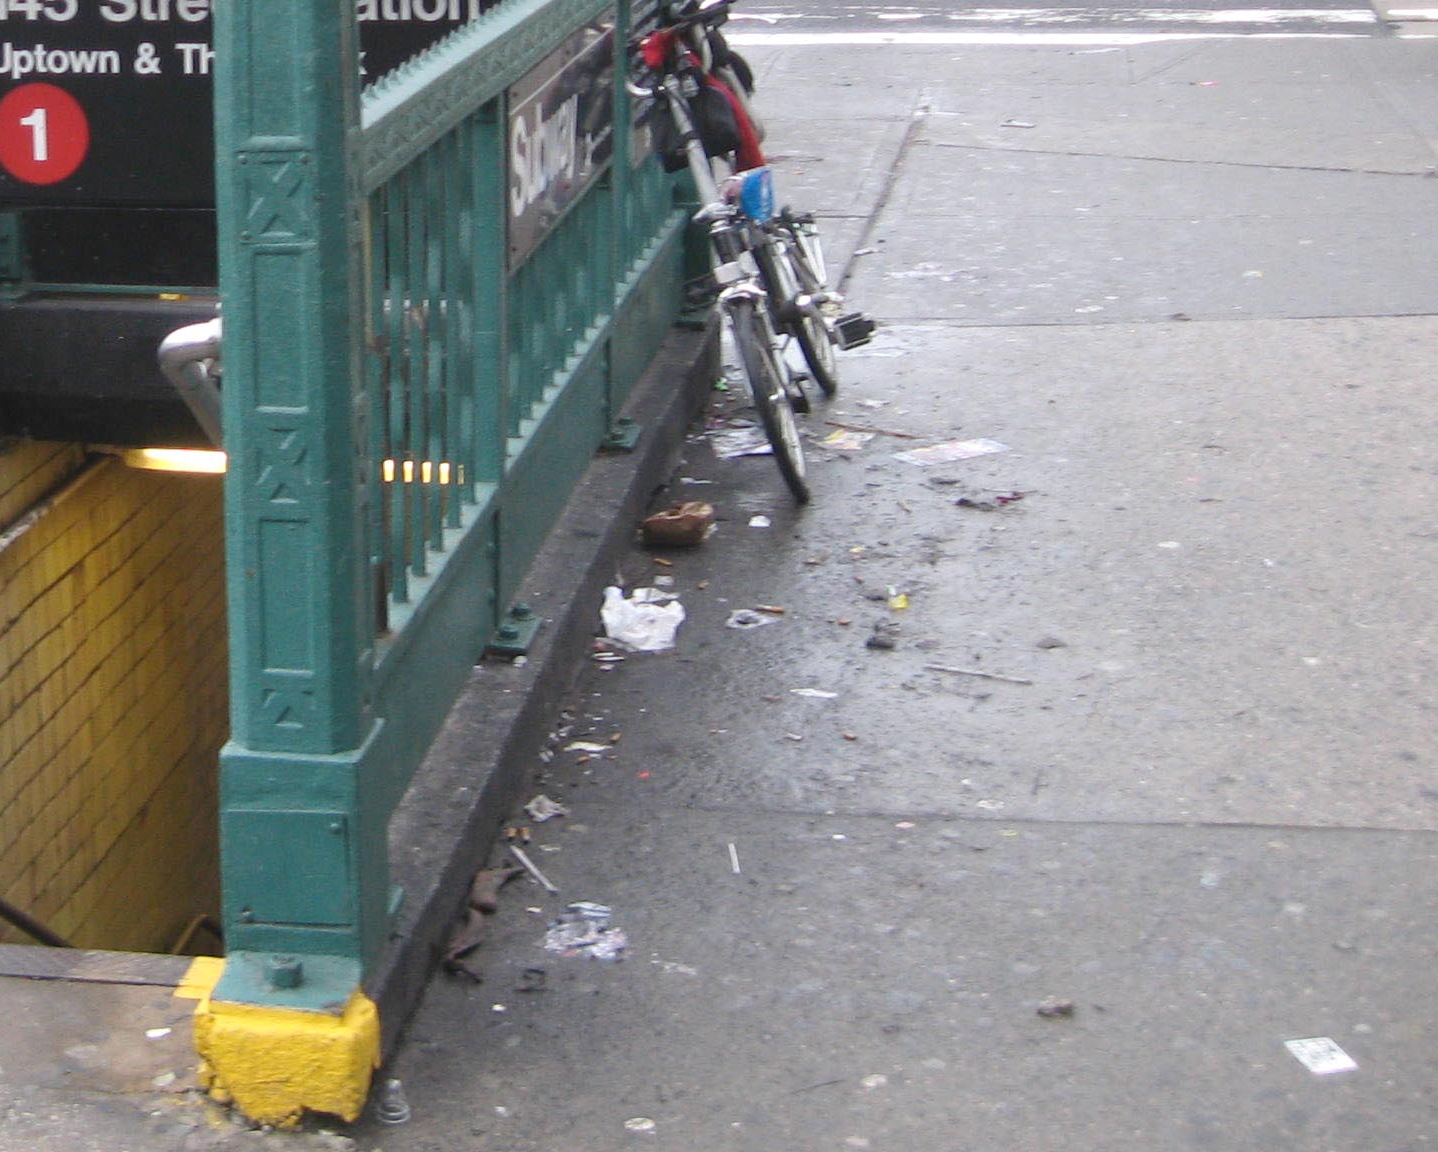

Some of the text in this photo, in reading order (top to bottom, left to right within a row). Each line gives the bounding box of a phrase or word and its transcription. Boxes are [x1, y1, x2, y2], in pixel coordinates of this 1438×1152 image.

[133, 42, 162, 75] &
[175, 42, 216, 75] Th
[19, 108, 48, 161] 1
